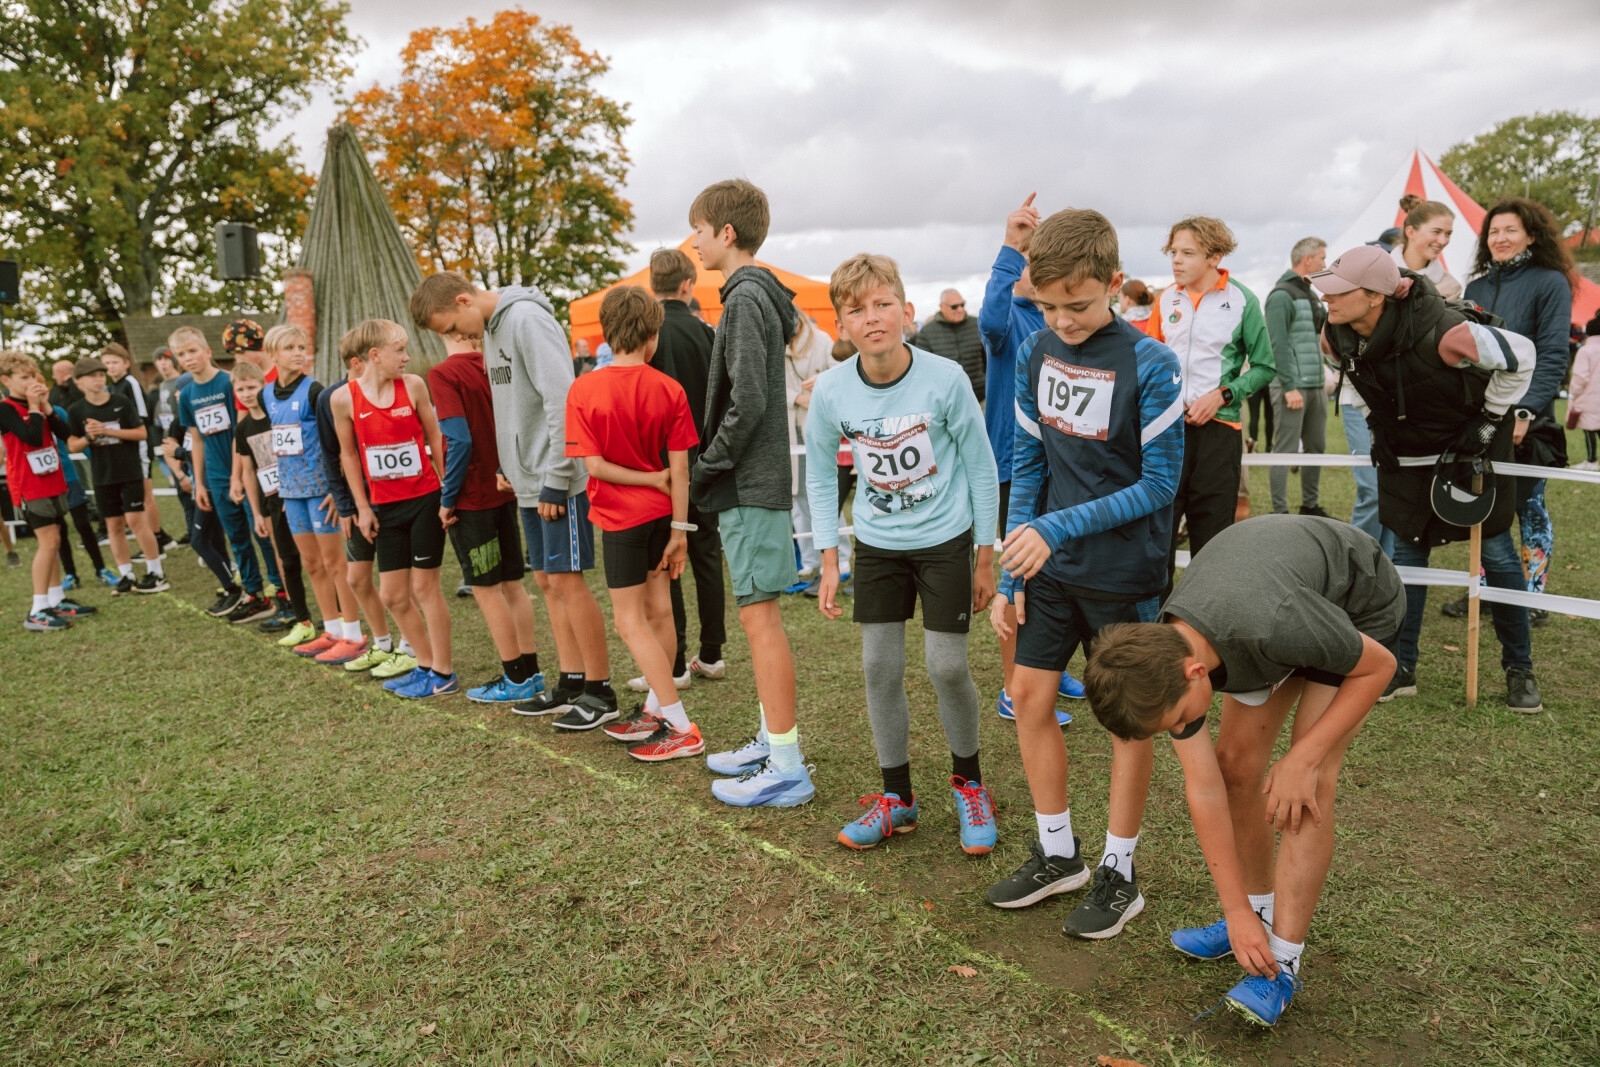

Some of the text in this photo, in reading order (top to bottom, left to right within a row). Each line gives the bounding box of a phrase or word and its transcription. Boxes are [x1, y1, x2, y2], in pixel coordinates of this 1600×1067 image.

[490, 366, 512, 385] PUMA
[1047, 376, 1097, 417] 197
[199, 412, 223, 428] 275
[374, 451, 413, 470] 106
[866, 445, 921, 476] 210
